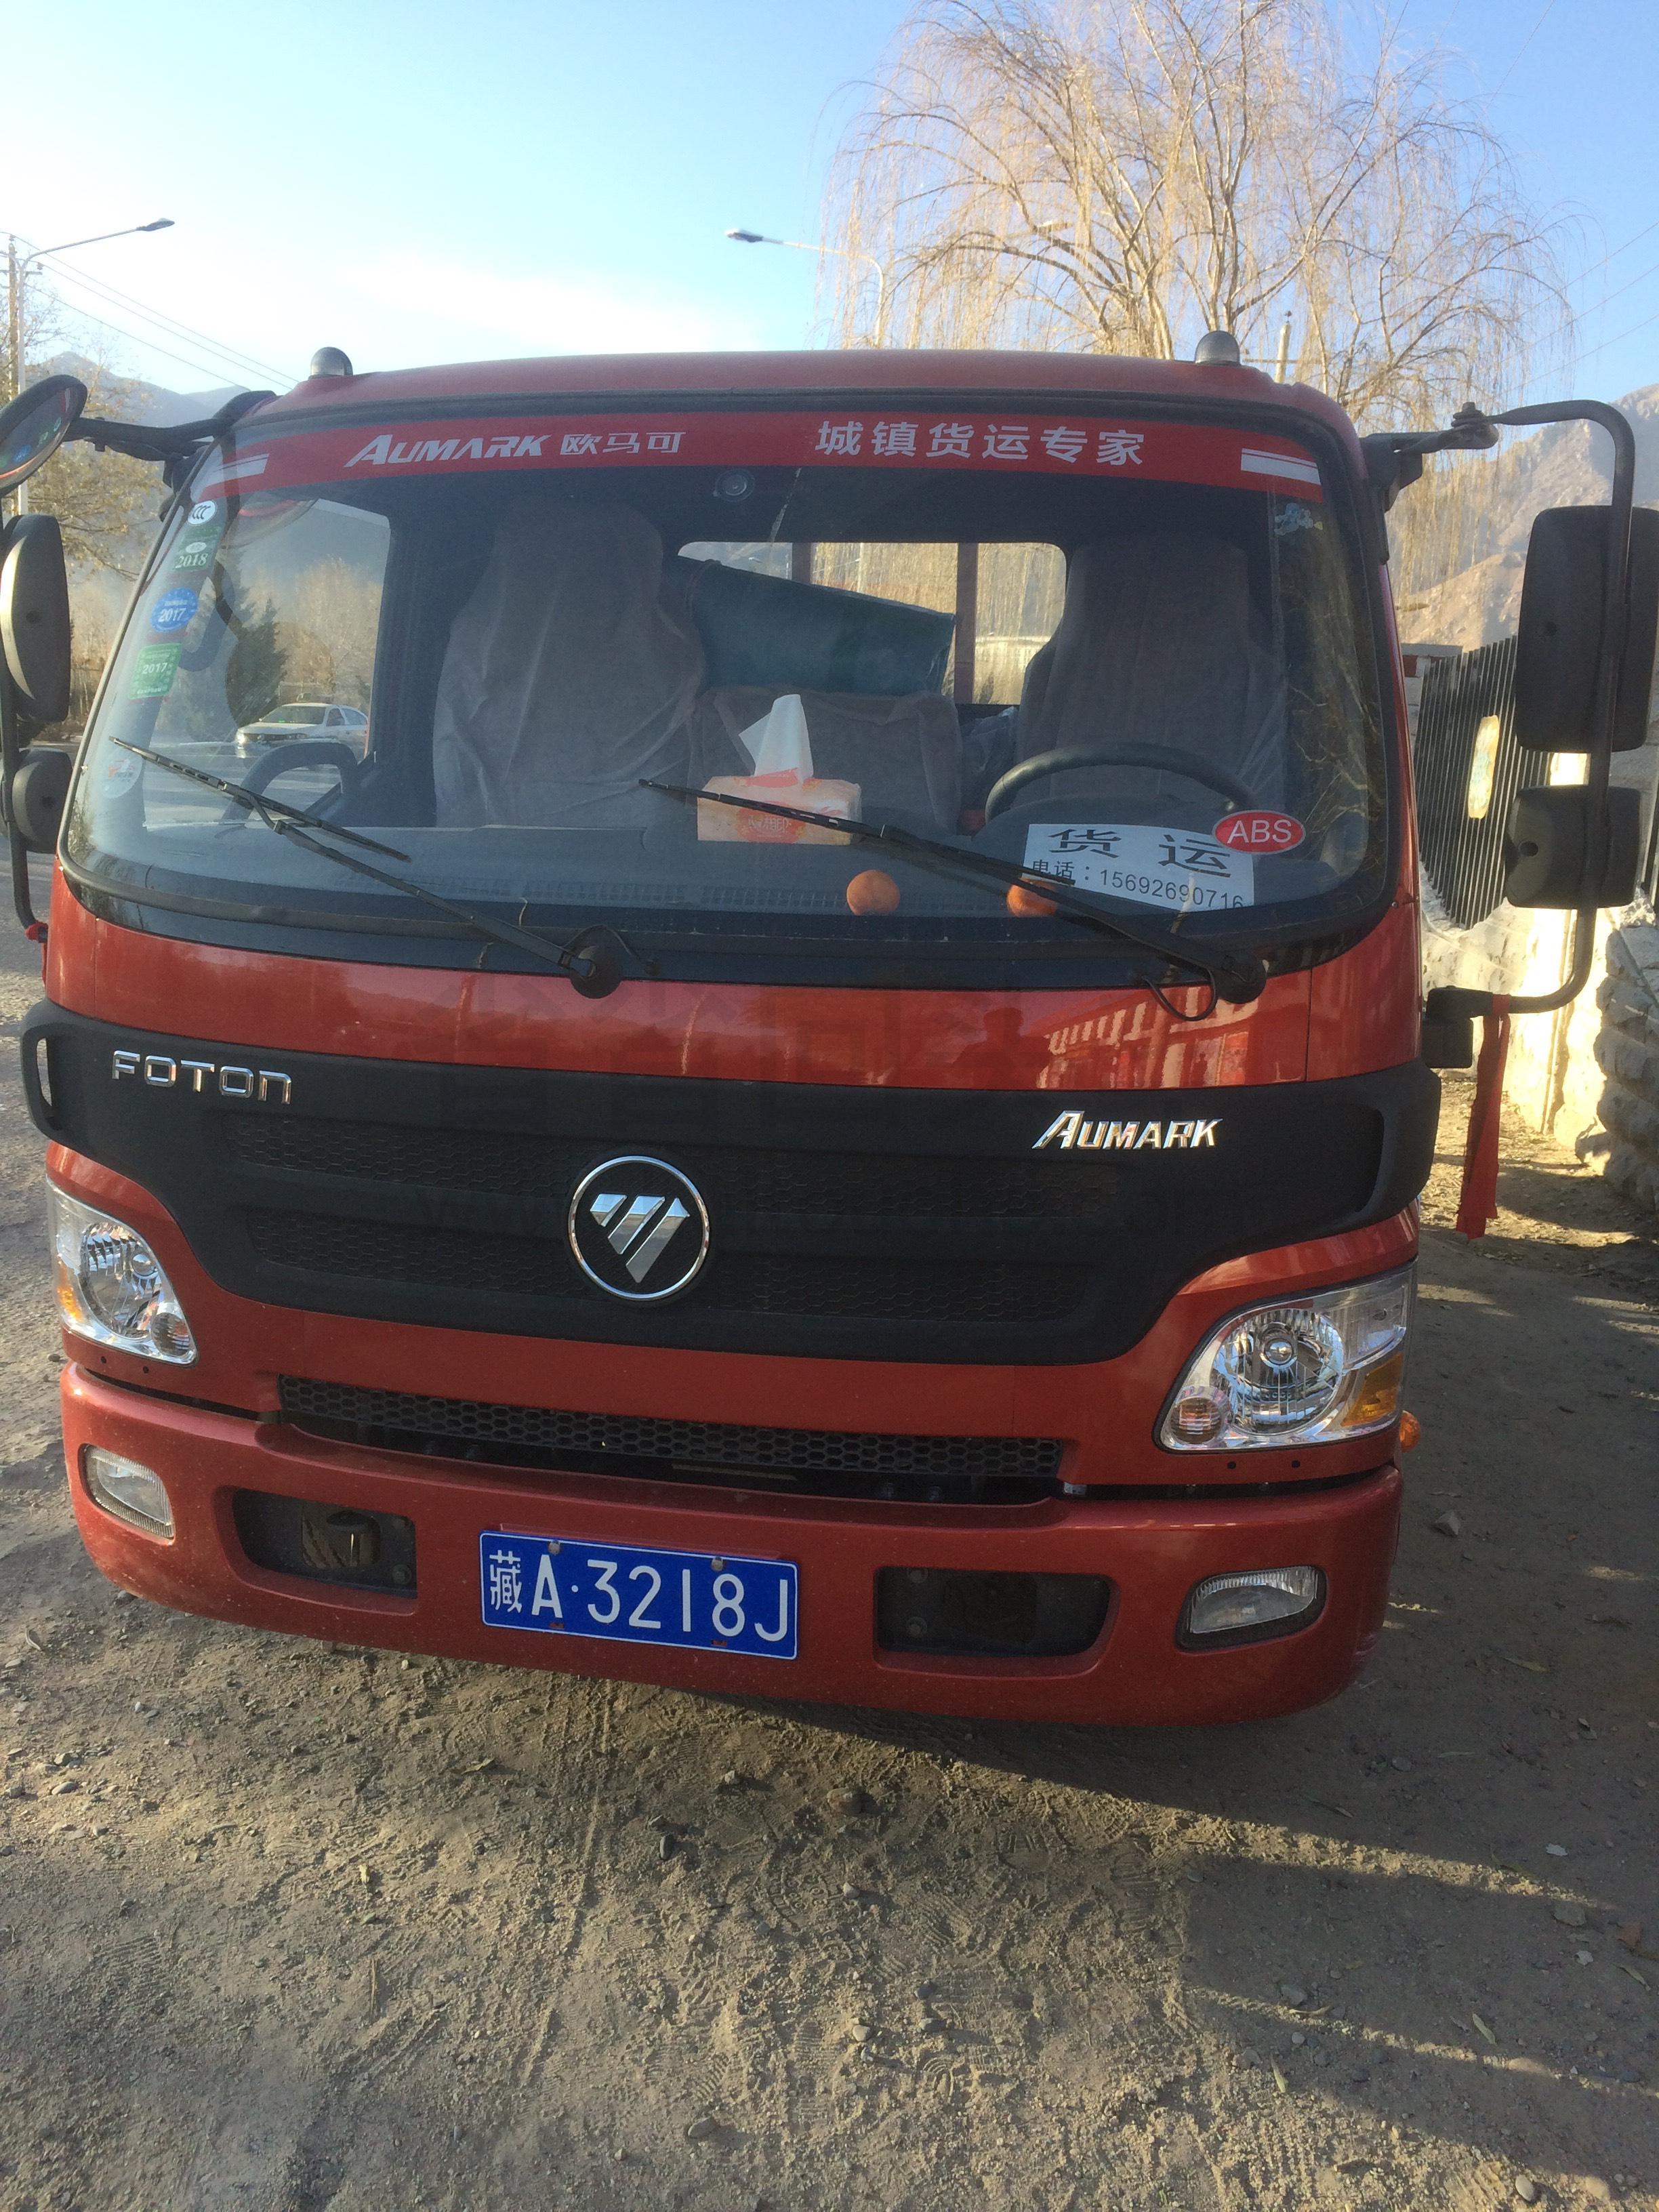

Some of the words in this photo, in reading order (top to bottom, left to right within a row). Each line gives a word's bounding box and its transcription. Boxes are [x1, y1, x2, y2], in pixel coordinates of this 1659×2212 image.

[344, 434, 552, 468] AUMARK
[559, 431, 687, 456] 欧马可
[814, 421, 1145, 466] 城镇货运专家
[175, 553, 209, 569] 2018
[158, 608, 187, 623] 2017
[142, 662, 168, 674] 2017
[1227, 819, 1292, 844] ABS
[1048, 828, 1231, 878] 货运
[1031, 1109, 1223, 1150] AUMARK
